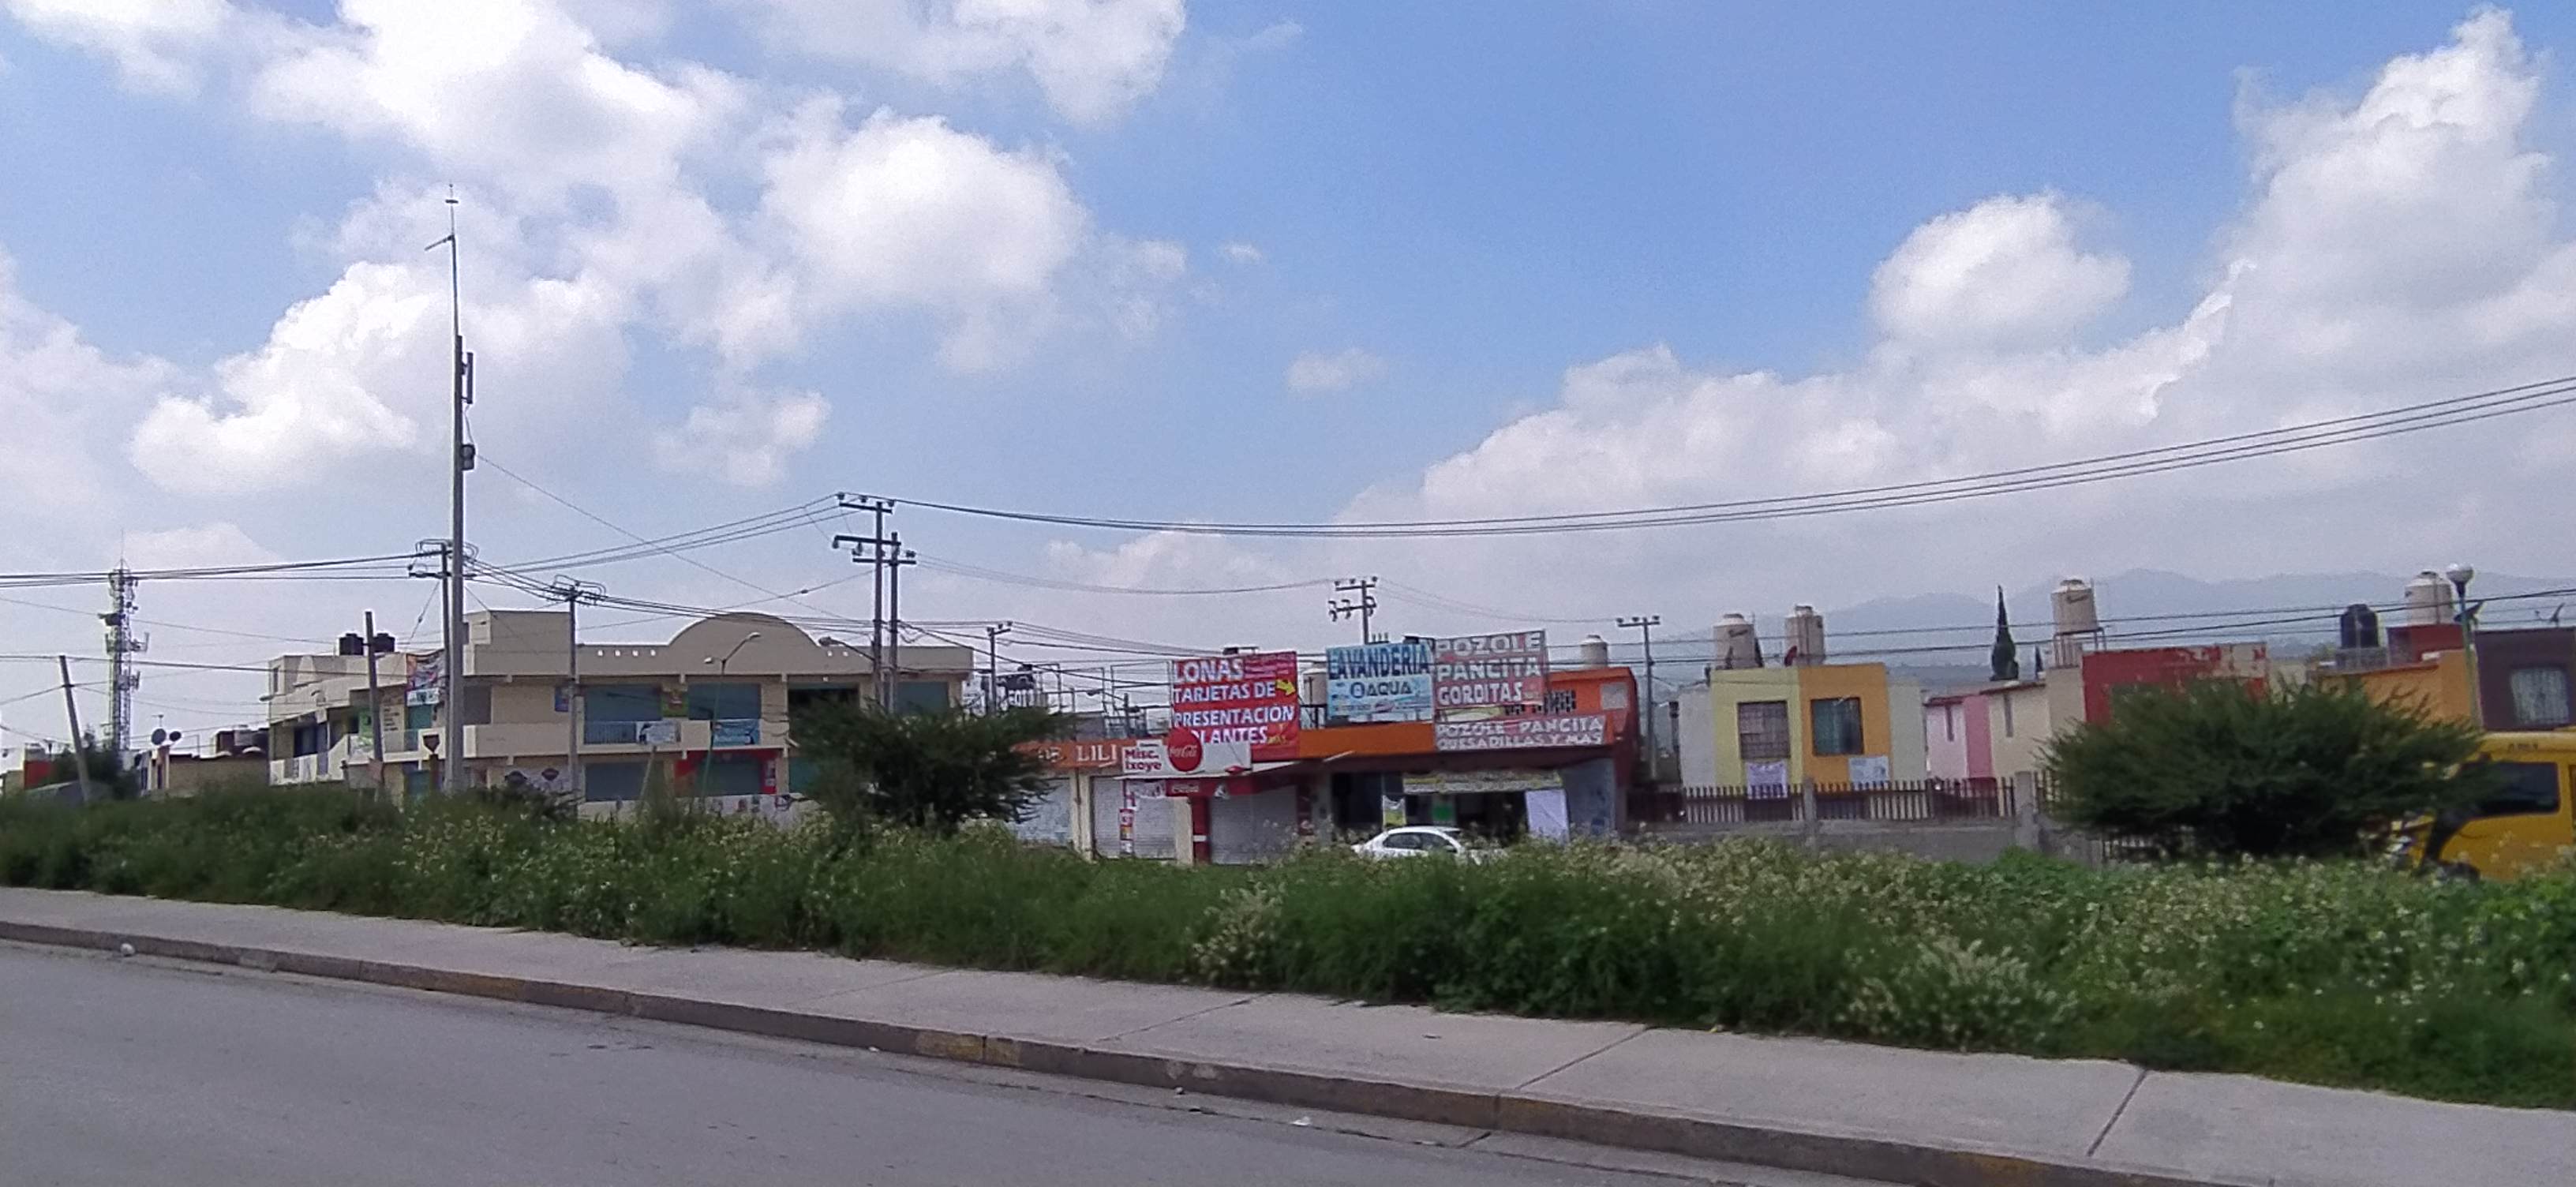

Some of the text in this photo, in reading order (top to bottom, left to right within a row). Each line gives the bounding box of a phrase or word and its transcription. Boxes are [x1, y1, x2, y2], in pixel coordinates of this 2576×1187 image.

[1435, 631, 1540, 658] POZOLE
[1173, 658, 1244, 683] LONAS
[1436, 657, 1541, 682] PANCITA
[1173, 681, 1276, 704] TARJETAS DE
[1437, 681, 1523, 706] GORDITAS
[1190, 725, 1268, 745] LANTES
[1436, 717, 1603, 738] POZOLE PANCITA
[1076, 743, 1117, 762] LILI
[1437, 734, 1544, 751] QUESADILLAS
[1549, 733, 1560, 744] Y
[1125, 748, 1159, 759] Misc.
